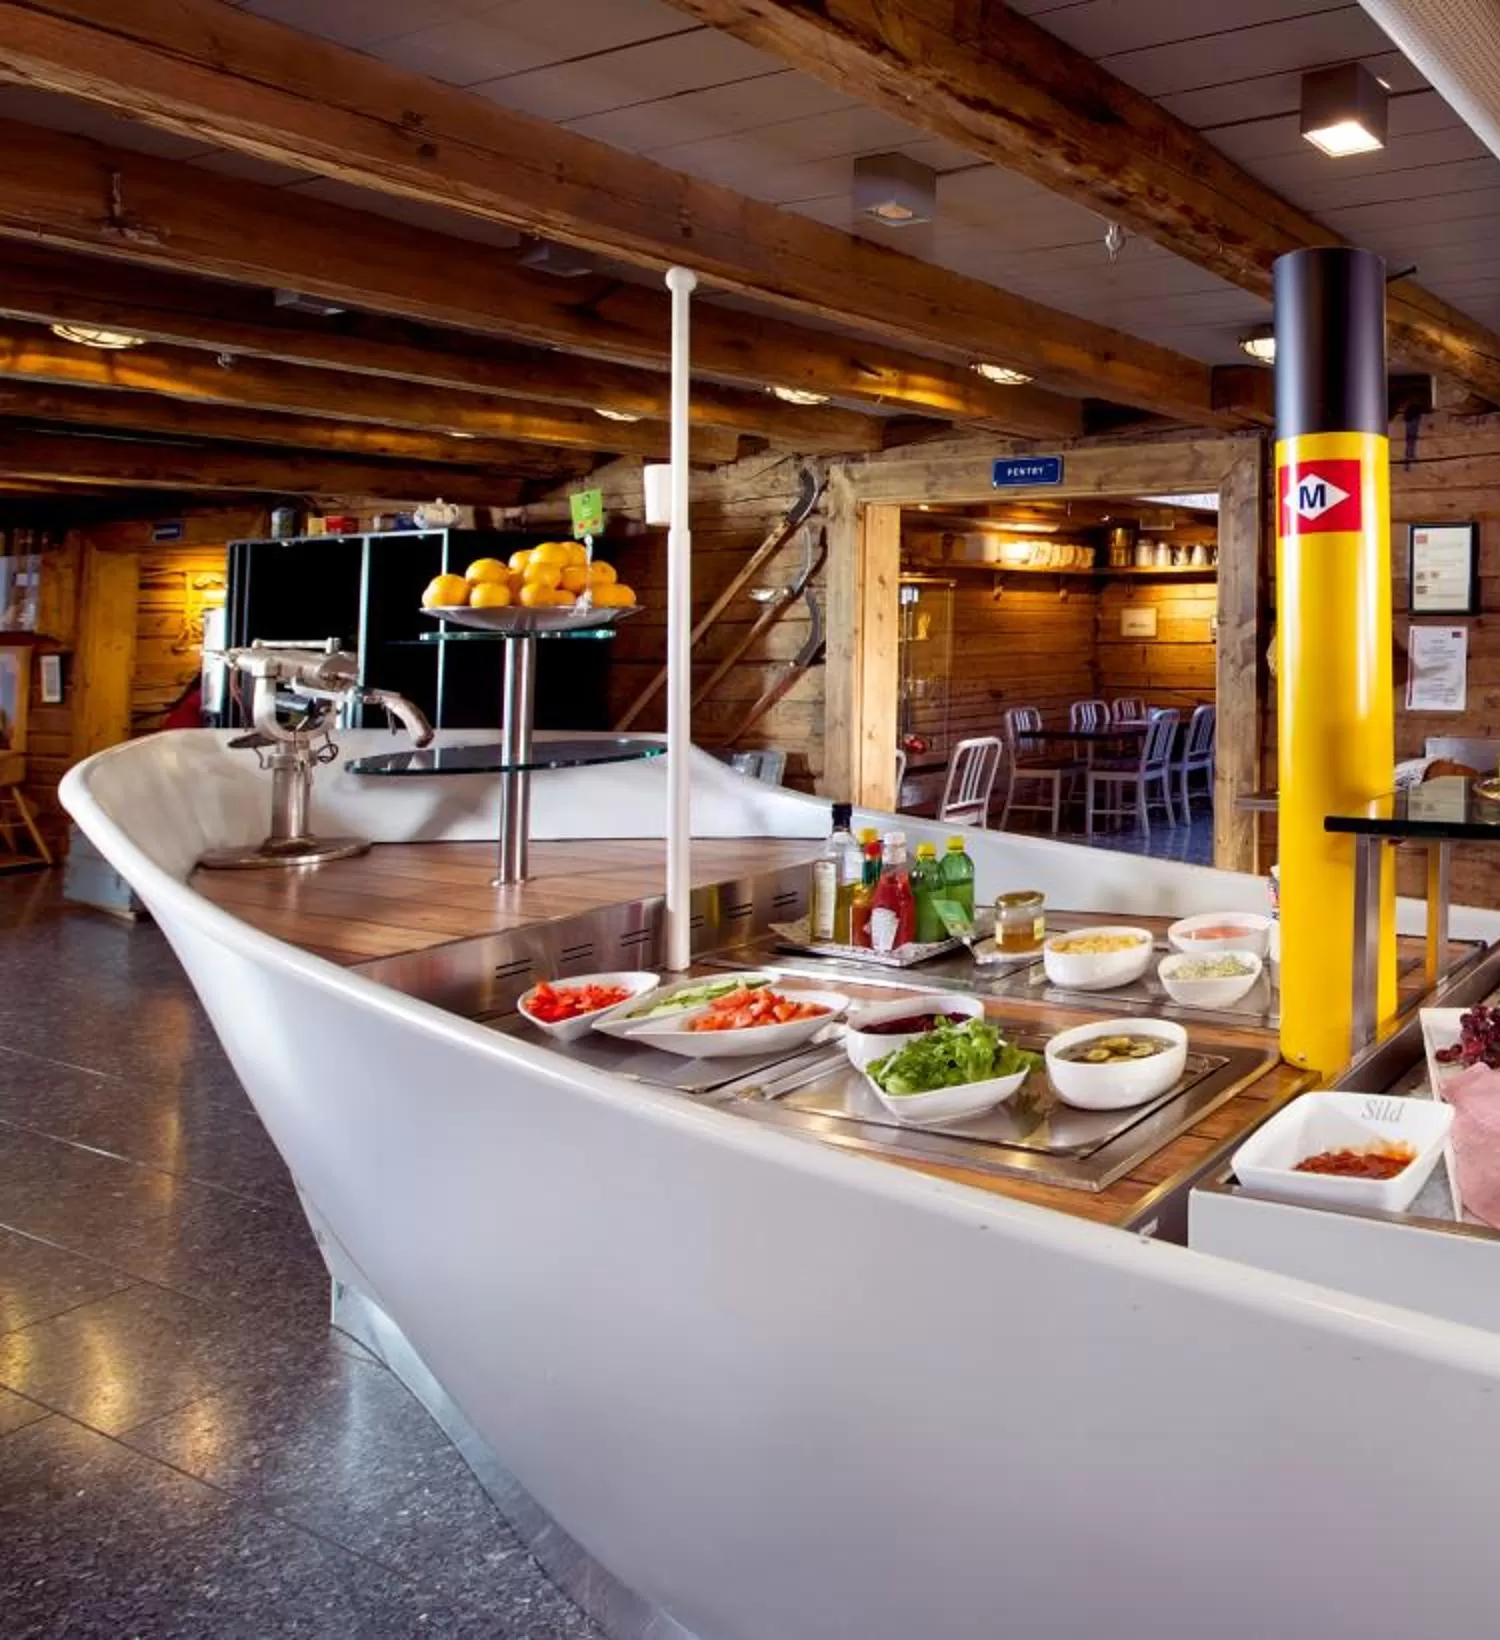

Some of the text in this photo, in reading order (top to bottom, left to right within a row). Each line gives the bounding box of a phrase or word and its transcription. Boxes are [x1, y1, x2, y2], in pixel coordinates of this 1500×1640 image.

[1006, 466, 1045, 477] PENTRY
[1299, 484, 1326, 510] M
[1361, 1099, 1405, 1123] Sild
